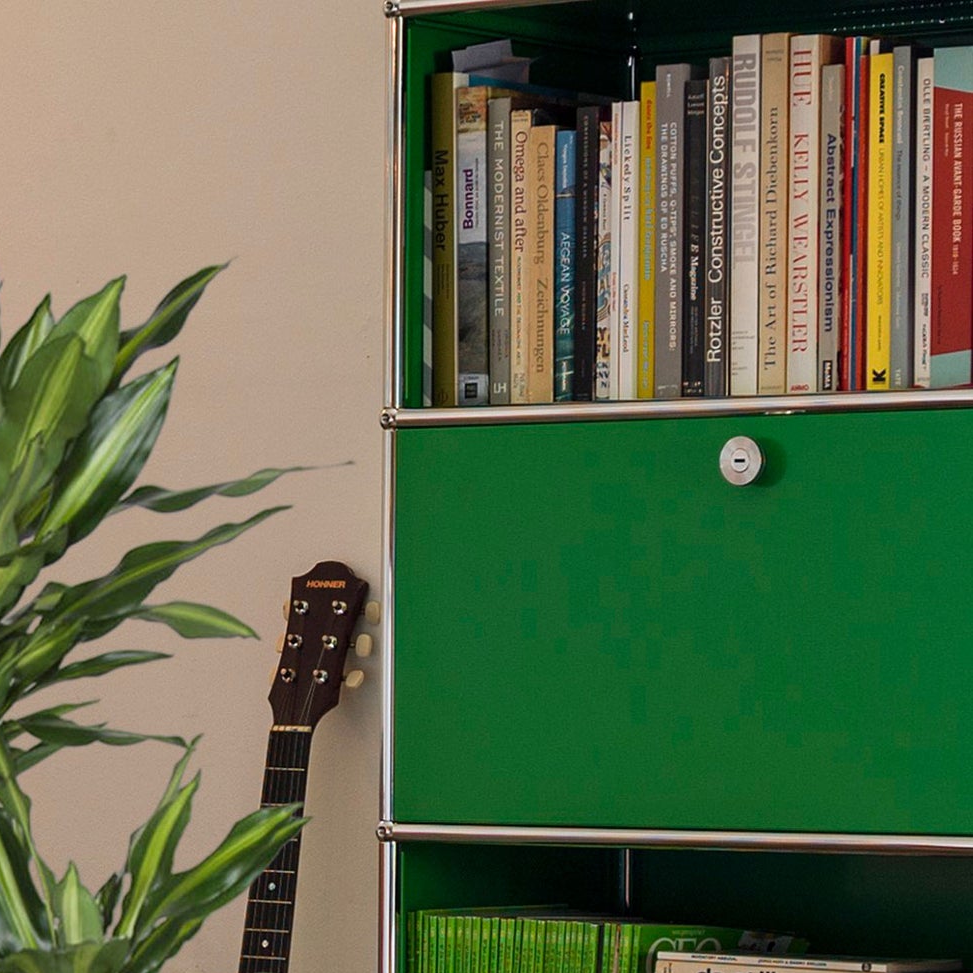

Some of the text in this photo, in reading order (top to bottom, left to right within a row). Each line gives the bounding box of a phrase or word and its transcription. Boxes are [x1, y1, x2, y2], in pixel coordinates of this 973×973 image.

[897, 65, 905, 108] Constantin
[923, 78, 931, 104] OLLE
[493, 120, 504, 151] THE
[623, 135, 632, 182] Lickedy
[733, 53, 756, 266] RUDOLF STINGEL
[434, 150, 449, 187] Max
[513, 131, 528, 252] Omega and after
[922, 174, 929, 182] A
[953, 103, 963, 243] THE RUSSIAN AVANT-GARDE BOOK
[434, 194, 449, 251] Huber
[463, 169, 474, 230] Bonnard
[493, 158, 504, 250] MODERNIST
[661, 201, 667, 214] OF
[661, 217, 667, 230] ED
[708, 76, 727, 362] Rotzler Constructive Concepts
[792, 48, 812, 353] HUE KELLY WEARSTLER
[921, 185, 929, 230] MODERN
[535, 142, 549, 373] Claes Oldenburg Zeichnungen
[765, 107, 778, 370] The Art of Richard Diebenkorn
[824, 133, 837, 332] Abstract Expressionism
[921, 233, 929, 279] CLASSIC
[493, 253, 504, 317] TEXTILE
[561, 232, 570, 334] AEGEAN VOYAGE
[689, 256, 699, 301] Magazine
[790, 383, 809, 392] AMMO
[306, 580, 346, 588] HOHNER
